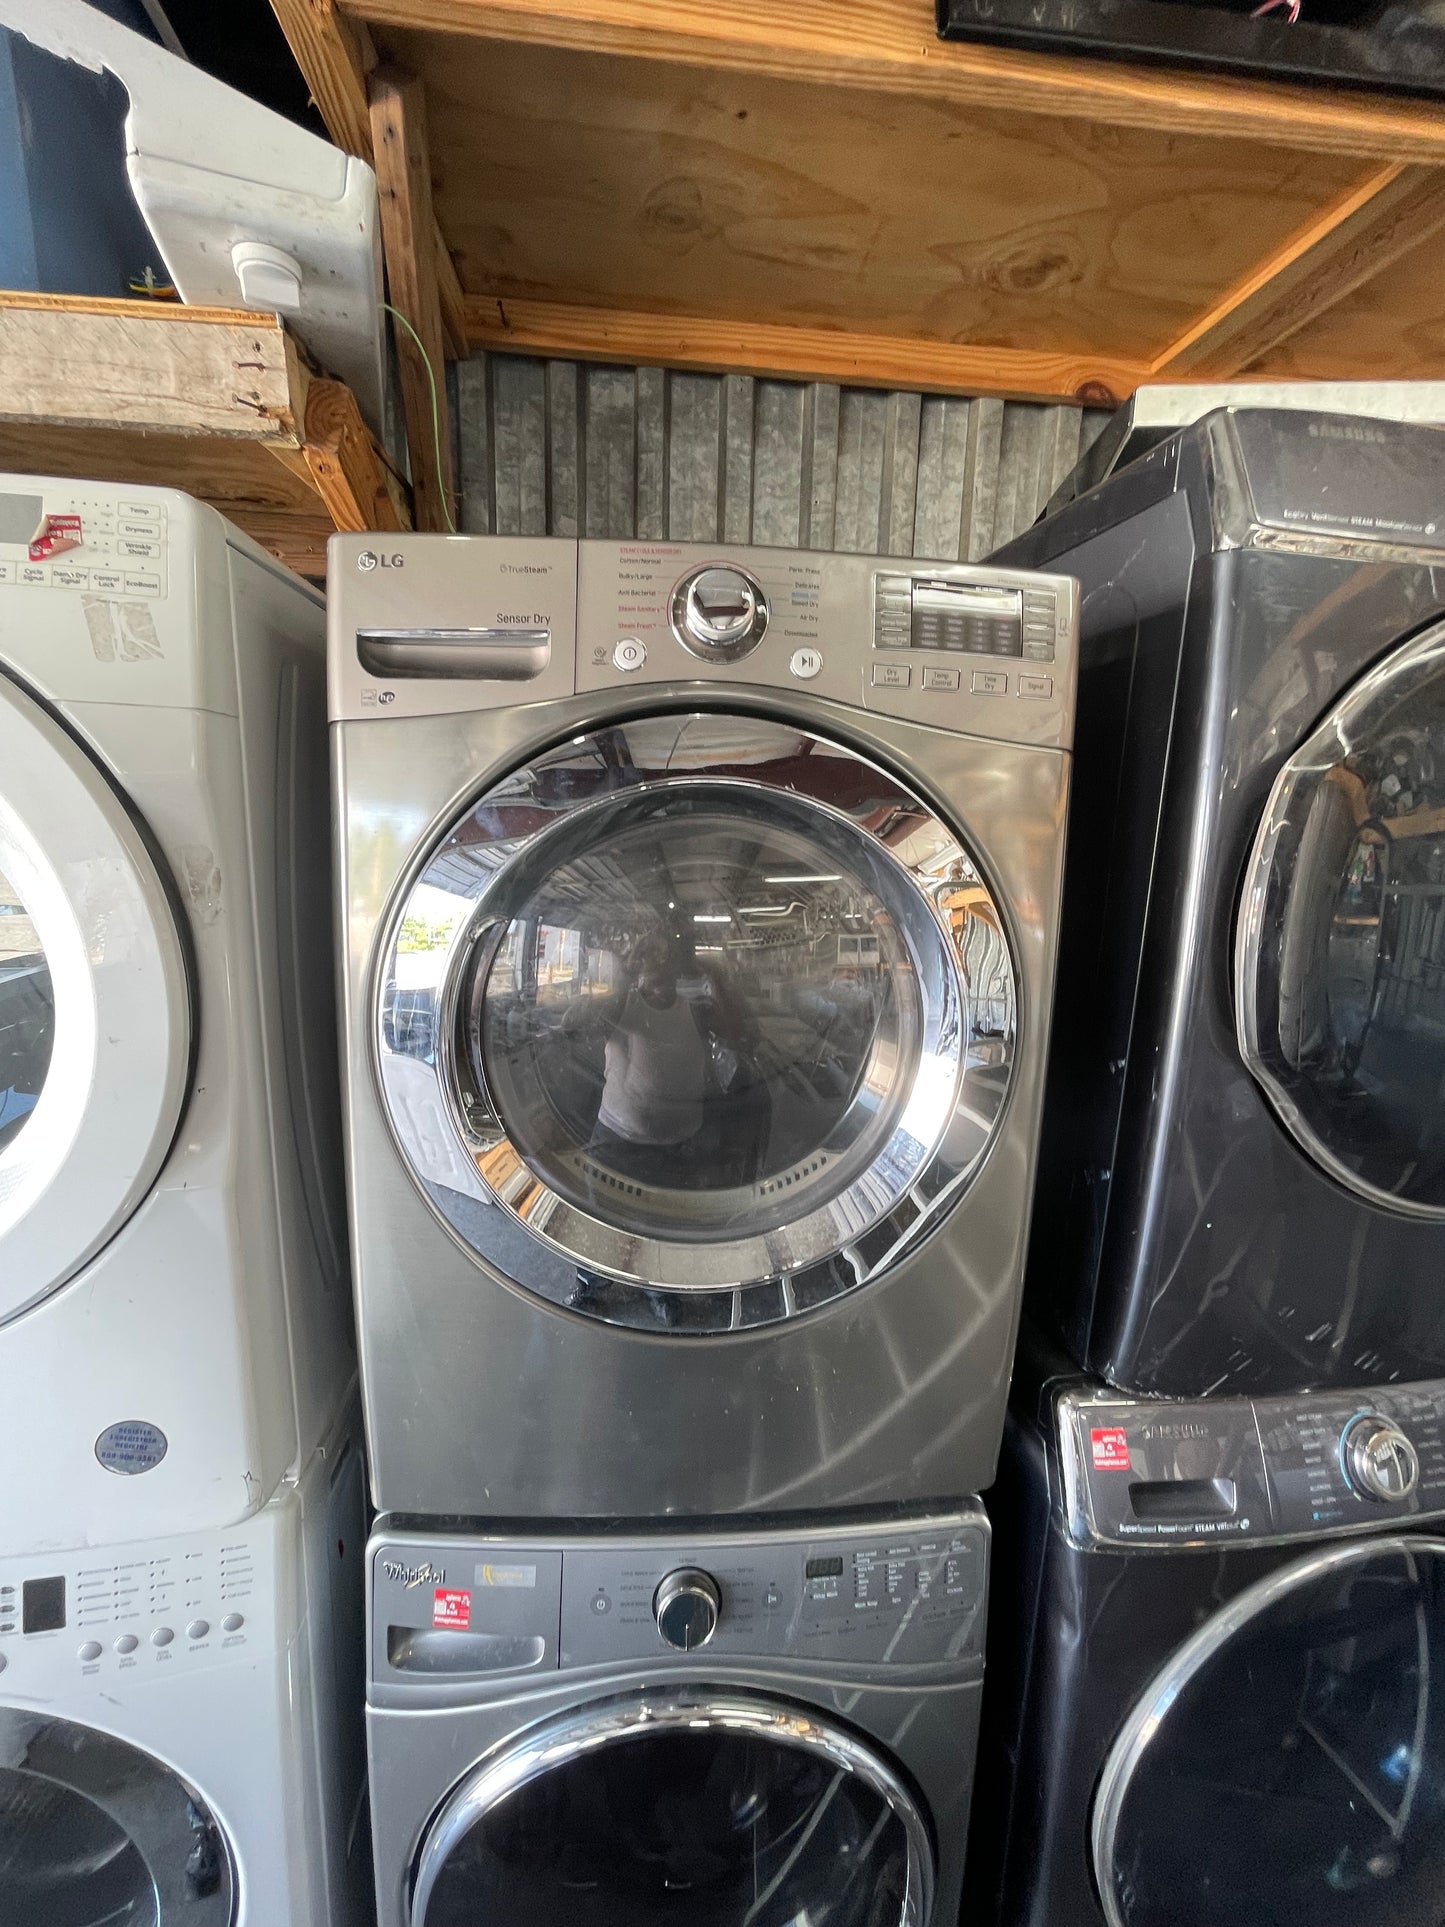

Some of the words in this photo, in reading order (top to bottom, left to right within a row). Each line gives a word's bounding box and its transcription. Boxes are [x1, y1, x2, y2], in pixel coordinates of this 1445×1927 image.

[130, 507, 149, 515] Temp
[125, 526, 153, 534] Dryness
[125, 542, 152, 550] Wrinkle
[128, 549, 149, 557] Shield
[381, 554, 404, 568] LG
[24, 568, 43, 576] Cycle
[23, 574, 44, 582] Signal
[61, 577, 81, 585] Signal
[93, 574, 120, 583] Control
[98, 580, 115, 588] Lock
[126, 581, 158, 589] EcoBoost
[496, 613, 531, 625] Sensor
[533, 613, 551, 625] Dry
[808, 614, 818, 622] Dry
[887, 669, 897, 677] Dry
[934, 671, 949, 680] Temp
[884, 675, 899, 683] Level
[931, 679, 952, 687] Control
[985, 682, 994, 690] Dry
[1027, 682, 1044, 690] Signal
[1141, 1423, 1209, 1439] SAMSUNG
[1119, 1522, 1156, 1534] SuperSpeed
[1195, 1523, 1215, 1533] STEAM
[383, 1561, 446, 1589] Whirlpool
